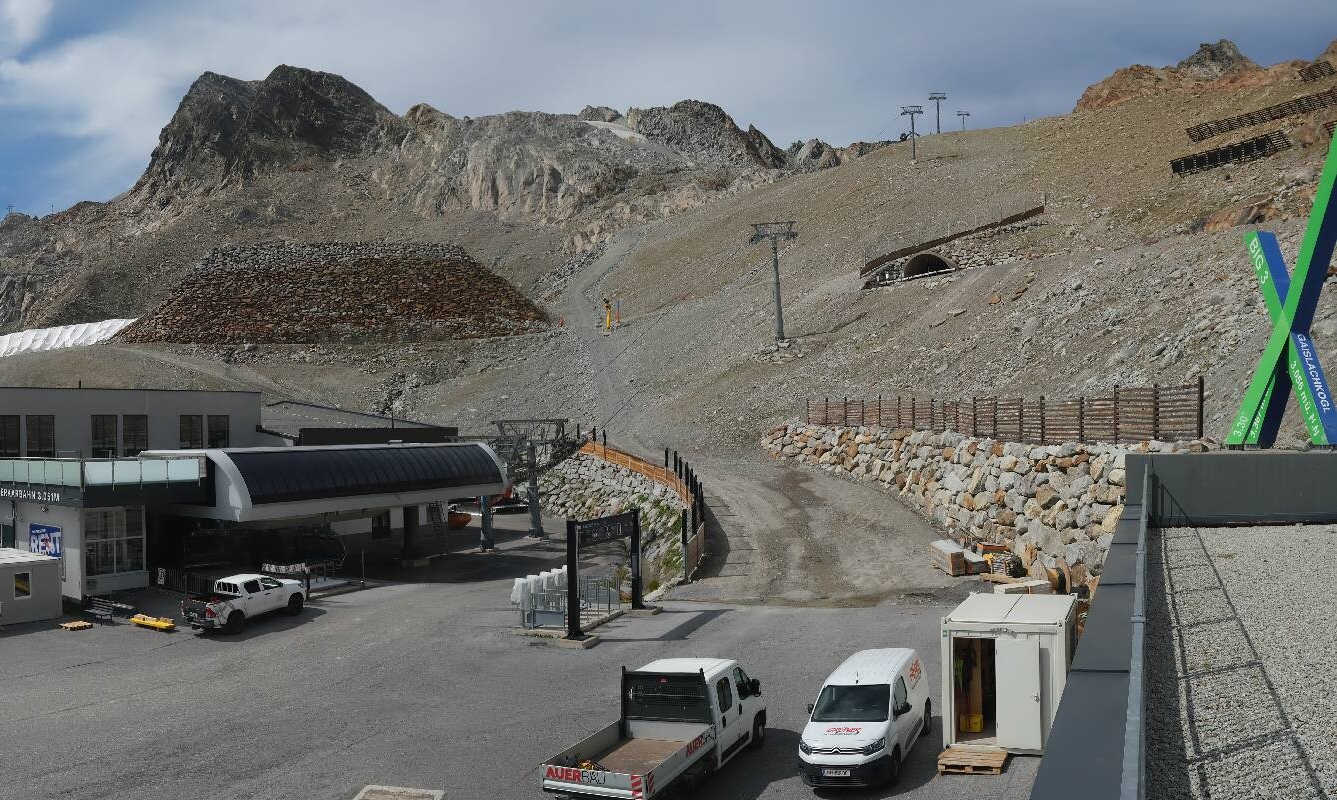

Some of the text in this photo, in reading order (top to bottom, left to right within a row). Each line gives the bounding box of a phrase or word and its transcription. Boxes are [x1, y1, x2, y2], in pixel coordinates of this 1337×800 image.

[1249, 237, 1269, 285] BIG 3
[1297, 333, 1330, 413] GAISLACHKOGL
